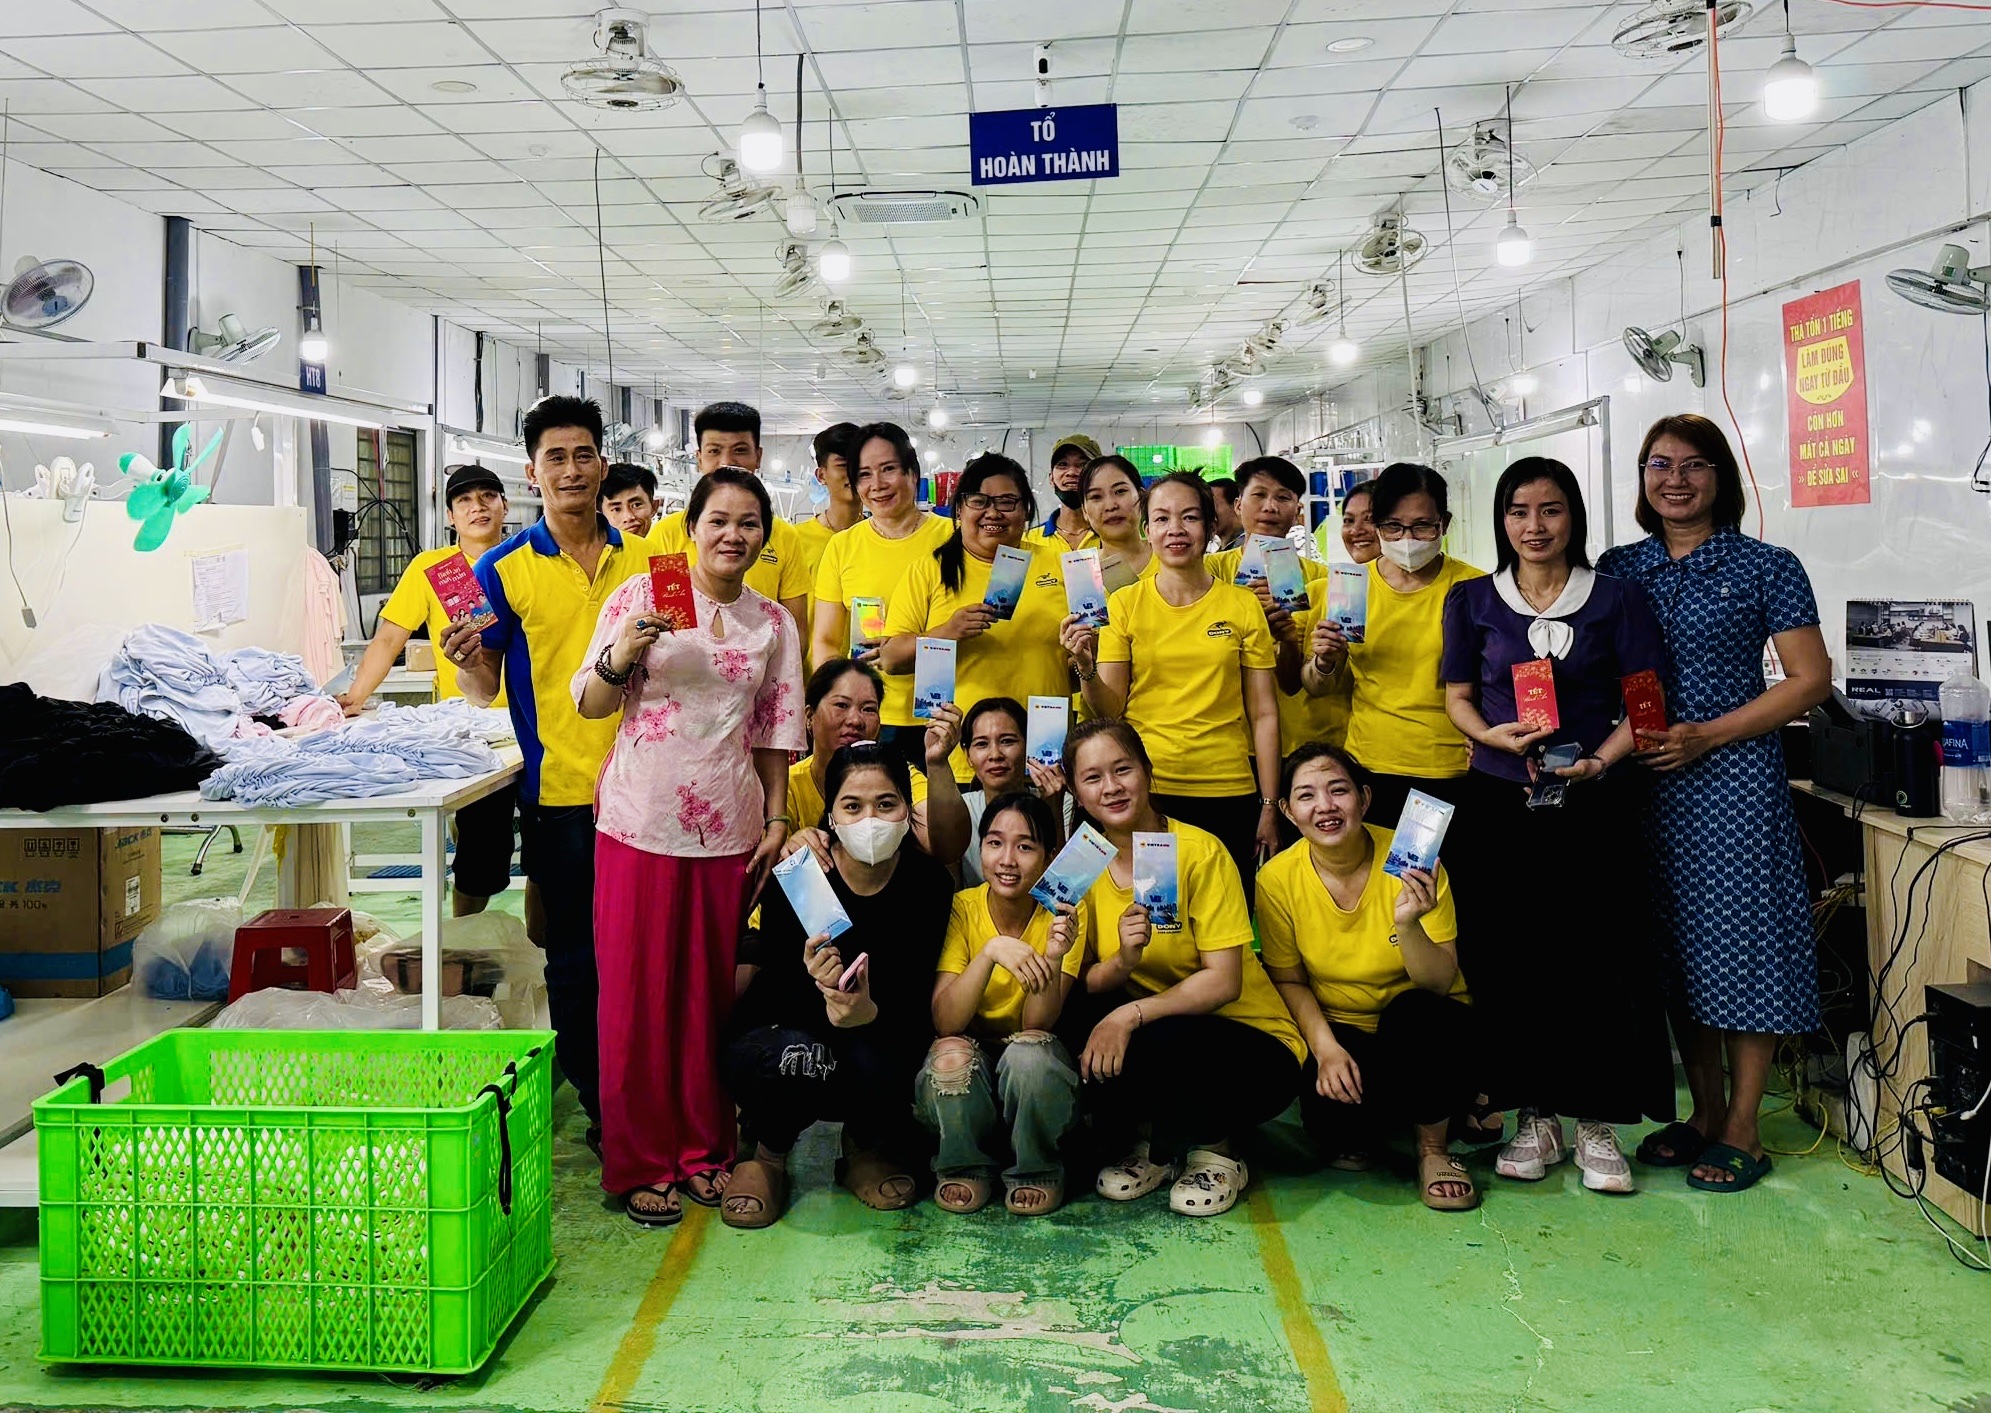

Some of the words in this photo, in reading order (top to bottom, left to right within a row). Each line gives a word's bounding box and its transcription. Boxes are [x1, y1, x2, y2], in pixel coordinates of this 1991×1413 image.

[1030, 111, 1056, 142] TỔ
[980, 151, 1036, 179] HOÀN
[1041, 147, 1110, 175] THÀNH
[1790, 320, 1805, 342] THÀ
[1805, 313, 1821, 338] TỐN
[1822, 317, 1827, 333] 1
[1829, 306, 1854, 331] TIẾNG
[1801, 348, 1819, 369] LÀM
[306, 365, 321, 388] HT8
[1799, 374, 1819, 393] NGAY
[1821, 368, 1831, 388] TỪ
[1807, 411, 1824, 432] CÒN
[1826, 409, 1844, 429] HƠN
[1799, 437, 1816, 460] MẤT
[1819, 435, 1830, 457] CẢ
[1832, 434, 1856, 456] NGÀY
[1818, 464, 1834, 486] SỬA
[1835, 467, 1849, 484] SAI
[1851, 686, 1882, 694] REAL
